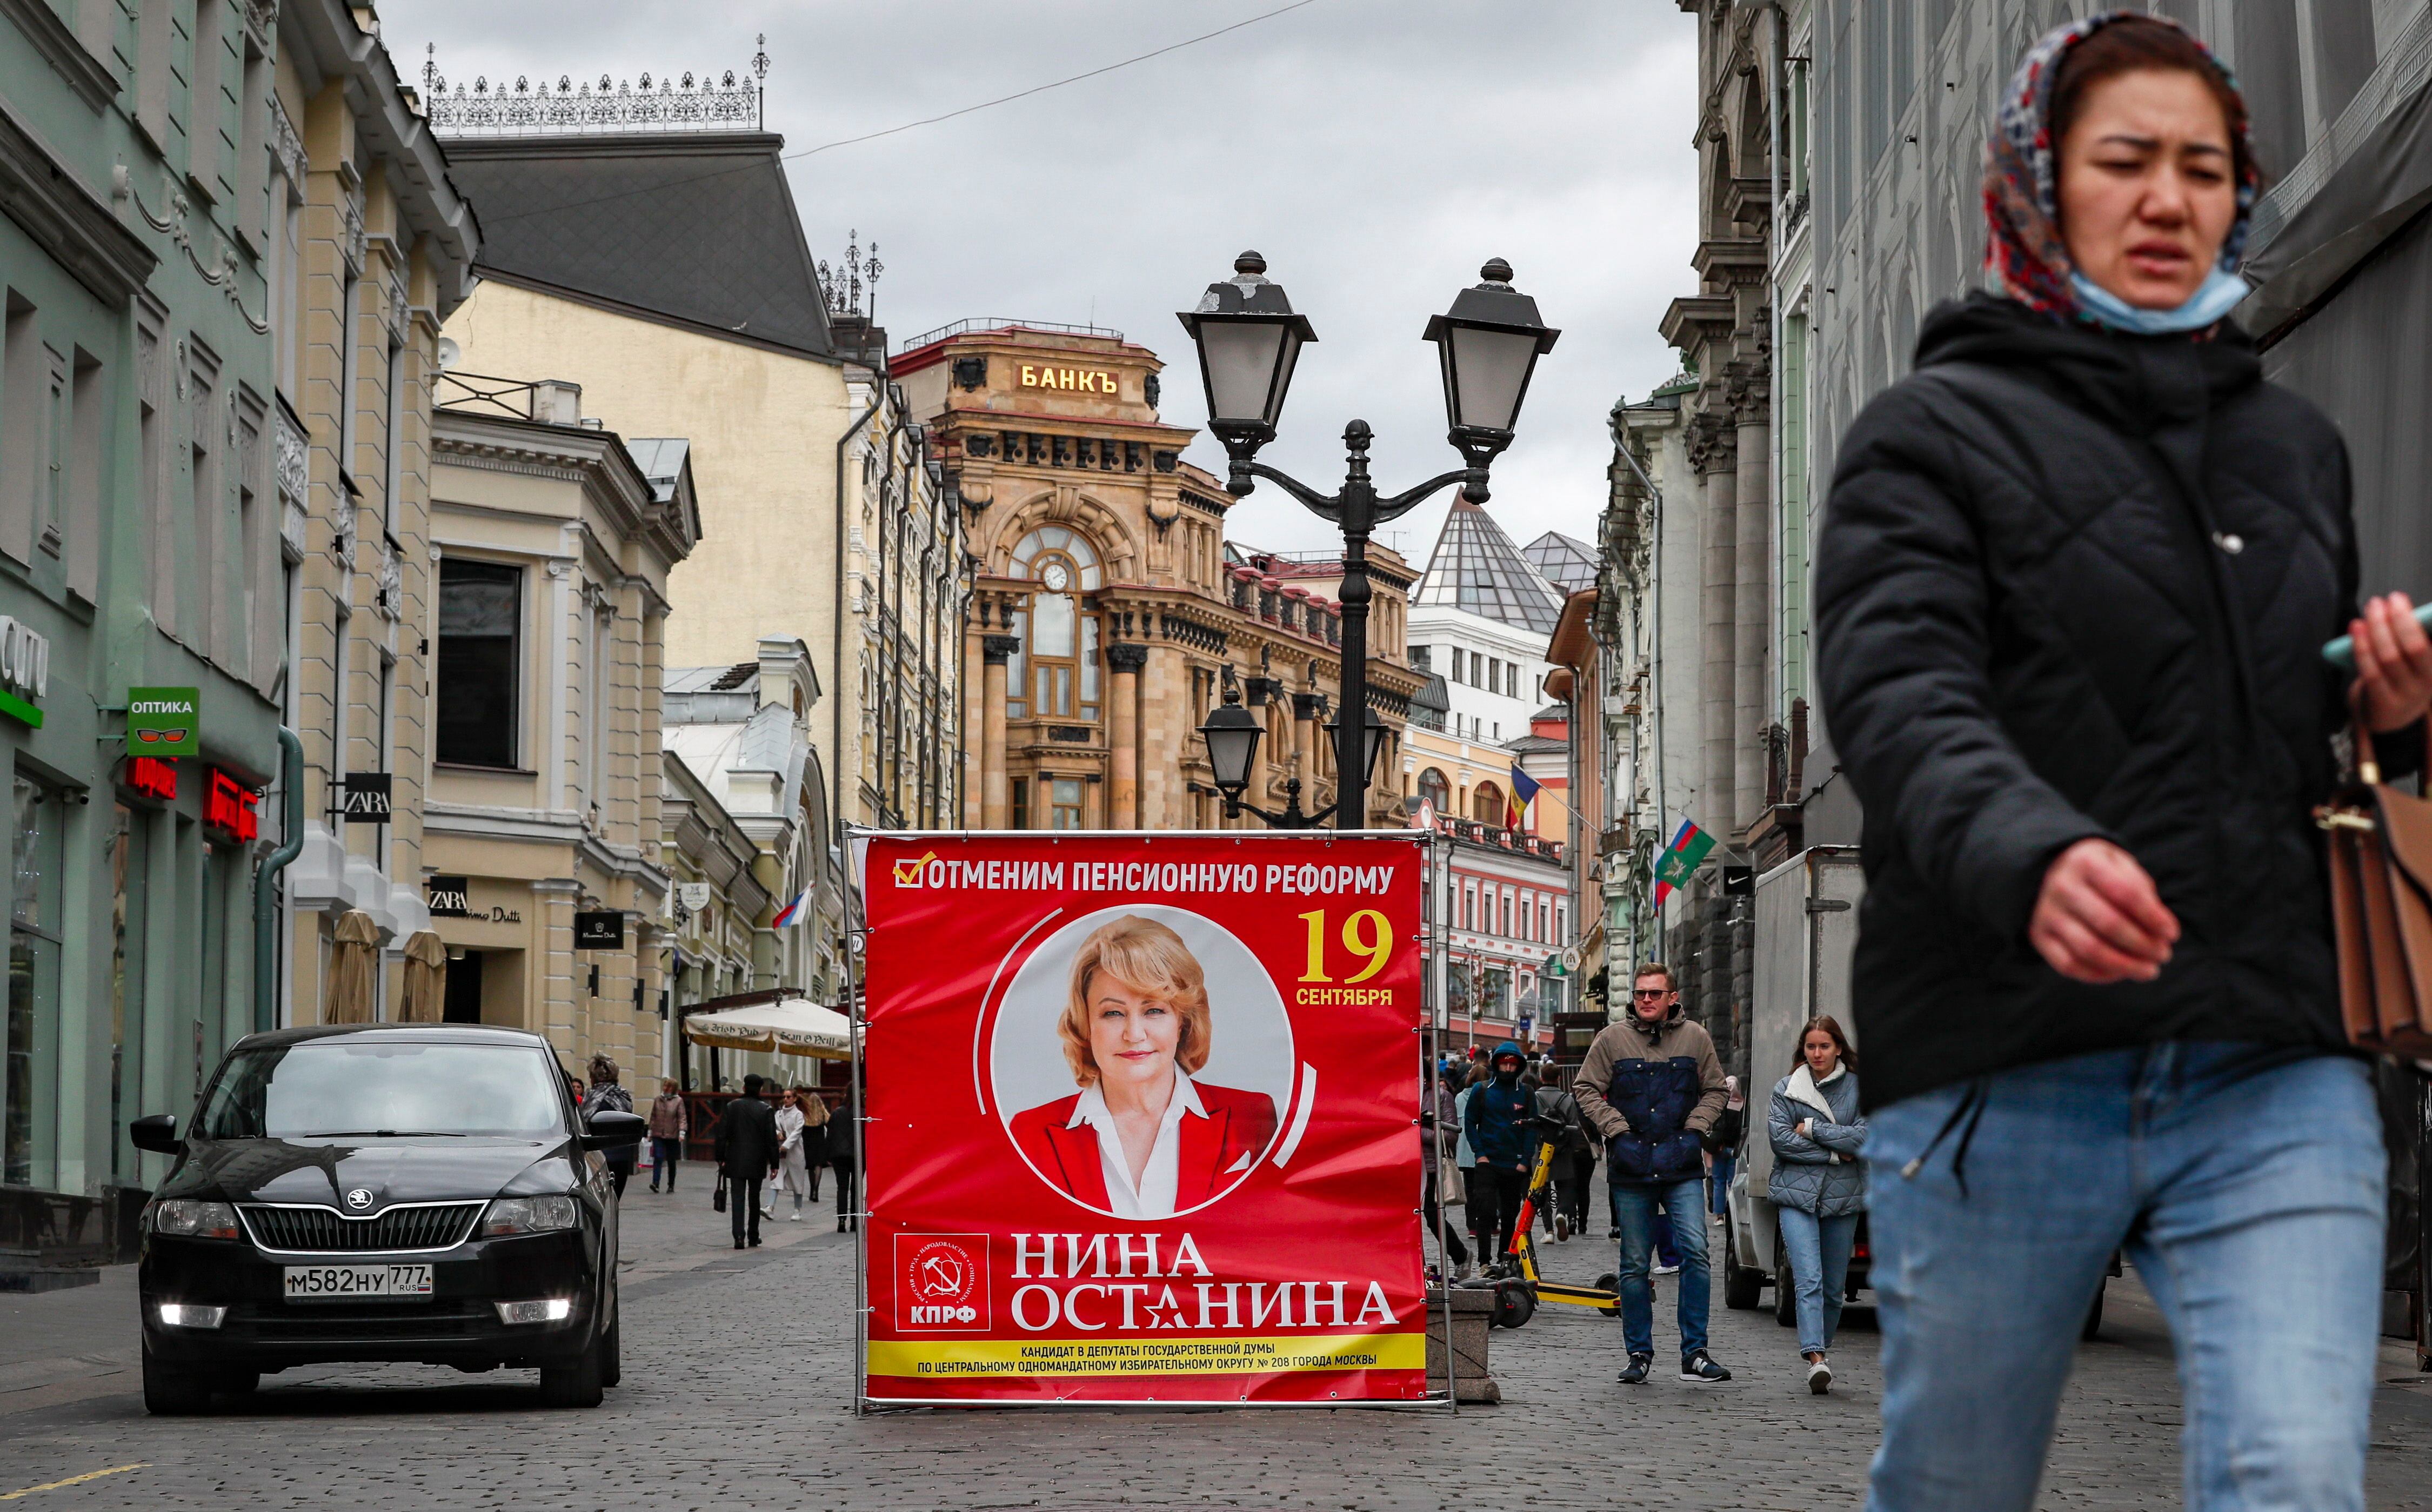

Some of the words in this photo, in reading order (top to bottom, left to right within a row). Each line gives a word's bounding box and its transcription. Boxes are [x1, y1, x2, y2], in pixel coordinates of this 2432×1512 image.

[1022, 365, 1117, 393] БАНКЪ
[131, 701, 192, 713] ОПТИКА
[345, 792, 390, 814] ZARA
[928, 859, 1064, 891] ОТМЕНИМ
[1072, 861, 1258, 893] ПЕНСИОННУЮ
[1265, 862, 1394, 896] РЕФОРМУ
[430, 891, 467, 909] ZARA
[492, 906, 521, 922] Dutti
[1297, 908, 1393, 984] 19
[1296, 988, 1393, 1006] СЕНТЯБРЯ
[711, 1023, 736, 1033] Irish
[738, 1026, 759, 1036] Pub
[919, 1241, 968, 1259] НАРОДОВЛАСТИЕ
[1010, 1233, 1214, 1279] НИНА
[909, 1257, 919, 1272] ТРУД
[291, 1269, 385, 1293] М582НУ
[390, 1267, 426, 1284] 777
[959, 1263, 975, 1302] СОЦИАЛИЗМ
[909, 1279, 925, 1302] РОССИЯ
[911, 1305, 977, 1323] КПРФ
[1011, 1281, 1400, 1332] ОСТАНИНА
[1021, 1346, 1075, 1359] КАНДИДАТ
[1078, 1346, 1085, 1356] В
[1087, 1345, 1140, 1358] ДЕПУТАТЫ
[1142, 1342, 1241, 1356] ГОСУДАРСТВЕННОЙ
[1244, 1343, 1275, 1355] ДУМЫ
[918, 1362, 932, 1373] ПО
[935, 1361, 1015, 1374] ЦЕНТРАЛЬНОМУ
[1018, 1360, 1117, 1373] ОДНОМАНДАТНОМУ
[1120, 1358, 1213, 1370] ИЗБИРАТЕЛЬНОМУ
[1216, 1357, 1254, 1369] ОКРУГУ
[1257, 1360, 1268, 1368] №
[1271, 1357, 1290, 1368] 208
[1293, 1355, 1332, 1367] ГОРОДА
[1334, 1354, 1377, 1366] МОСКВЫ
